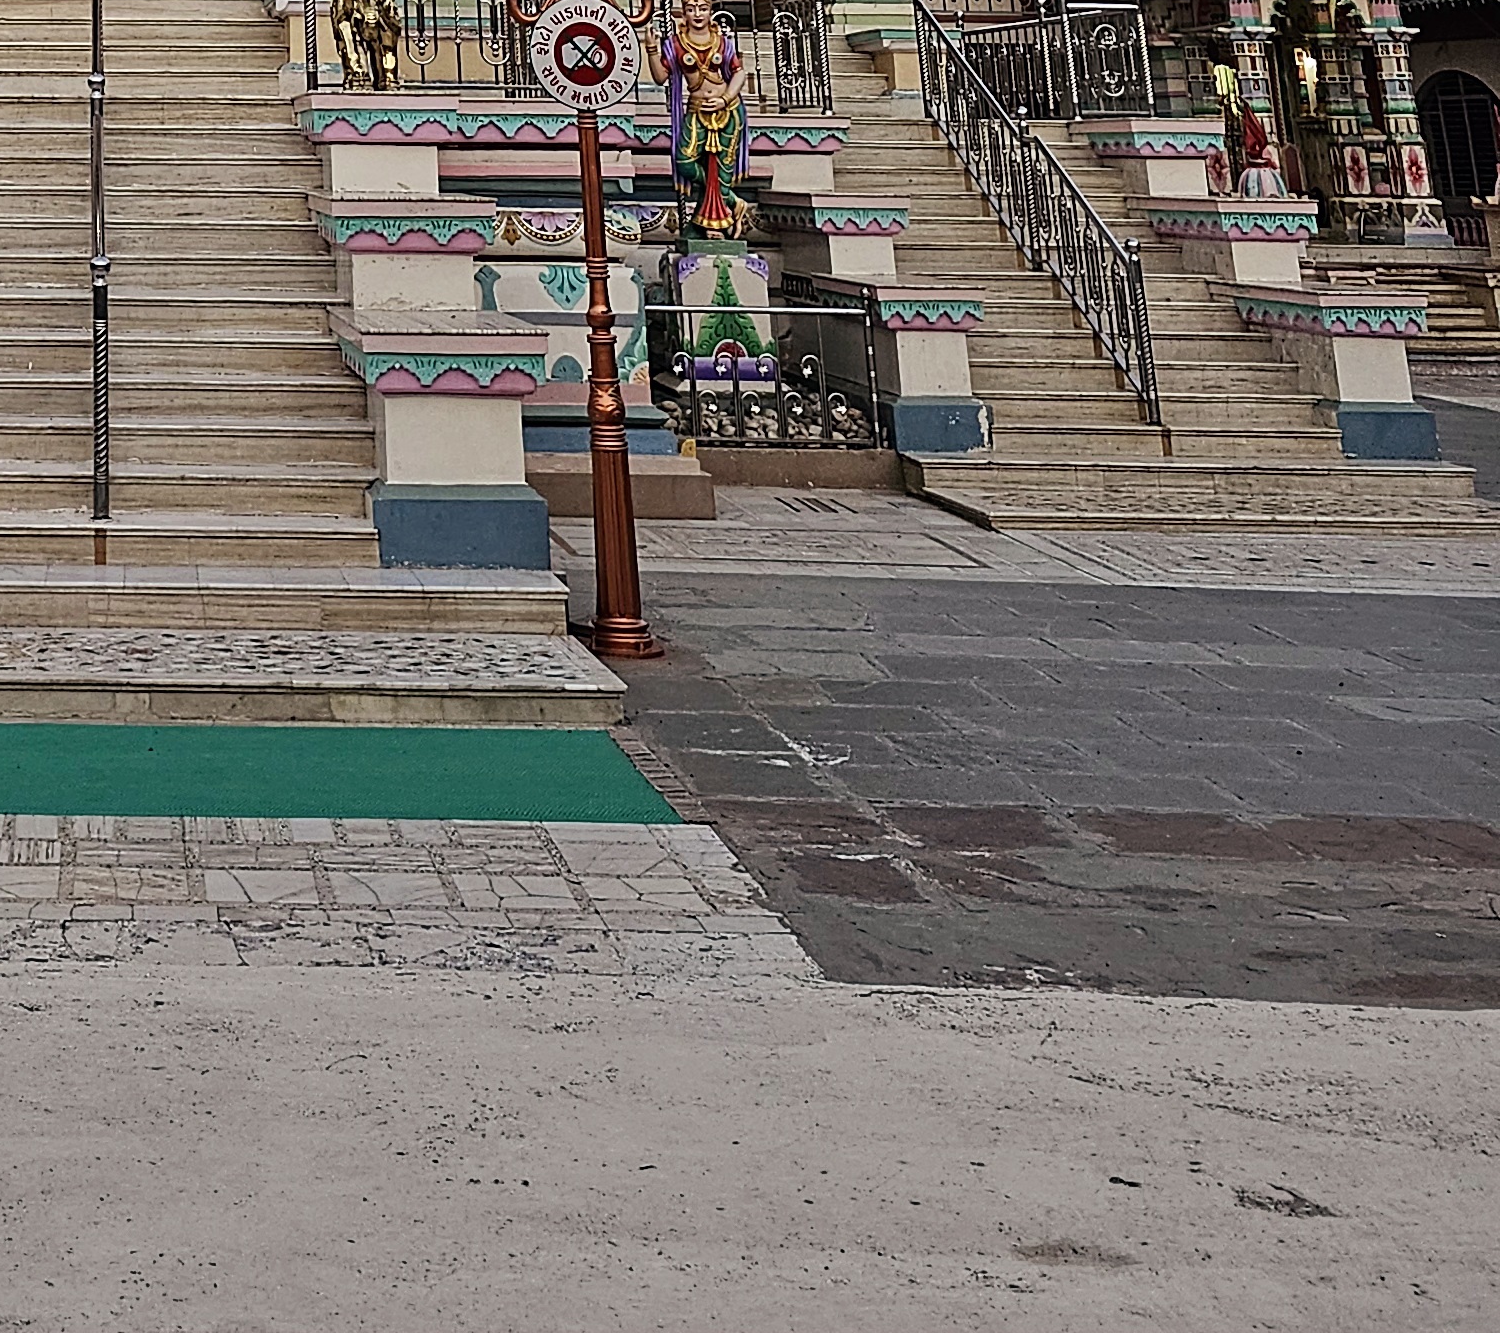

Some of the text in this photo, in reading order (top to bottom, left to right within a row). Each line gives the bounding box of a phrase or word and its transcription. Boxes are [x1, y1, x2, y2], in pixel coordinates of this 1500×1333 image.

[531, 25, 553, 55] ફોટો
[550, 5, 607, 26] પાડવાની
[607, 18, 631, 51] મંદિર
[570, 84, 609, 105] મનાઈ
